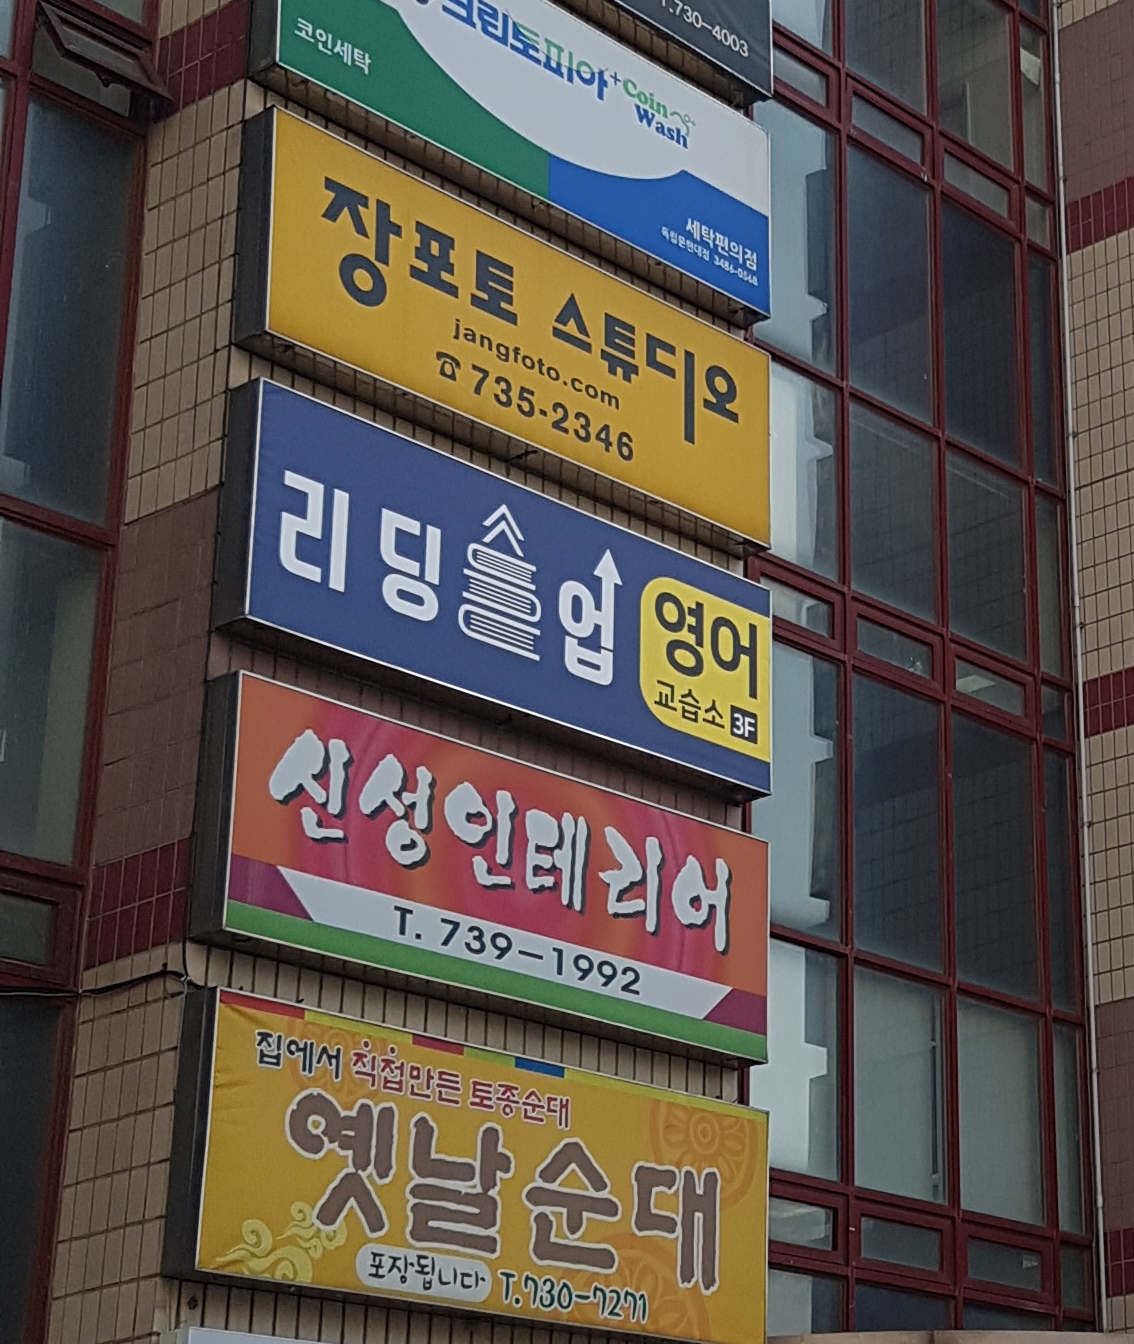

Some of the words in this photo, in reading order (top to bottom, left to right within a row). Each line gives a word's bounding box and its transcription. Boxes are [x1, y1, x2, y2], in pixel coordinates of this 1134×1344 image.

[294, 17, 372, 75] 코인세탁
[621, 77, 669, 121] Coin
[635, 104, 689, 149] Wash
[686, 218, 758, 272] 세탁편의점
[321, 176, 519, 326] 장포토
[552, 293, 739, 446] 스튜디오
[453, 319, 620, 411] jangfoto.com
[471, 364, 634, 461] 735-2346
[654, 592, 757, 699] 영어
[654, 680, 725, 729] 교습소
[732, 713, 757, 740] 3F
[269, 730, 731, 954] 신성인테리어
[440, 918, 641, 995] 739-1992
[256, 1030, 343, 1081] 집에서
[351, 1041, 461, 1104] 직접만든
[469, 1077, 571, 1130] 토종순대
[285, 1089, 721, 1294] 옛날순대
[369, 1252, 487, 1291] 포장됩니다
[499, 1270, 649, 1324] T.730-7271
